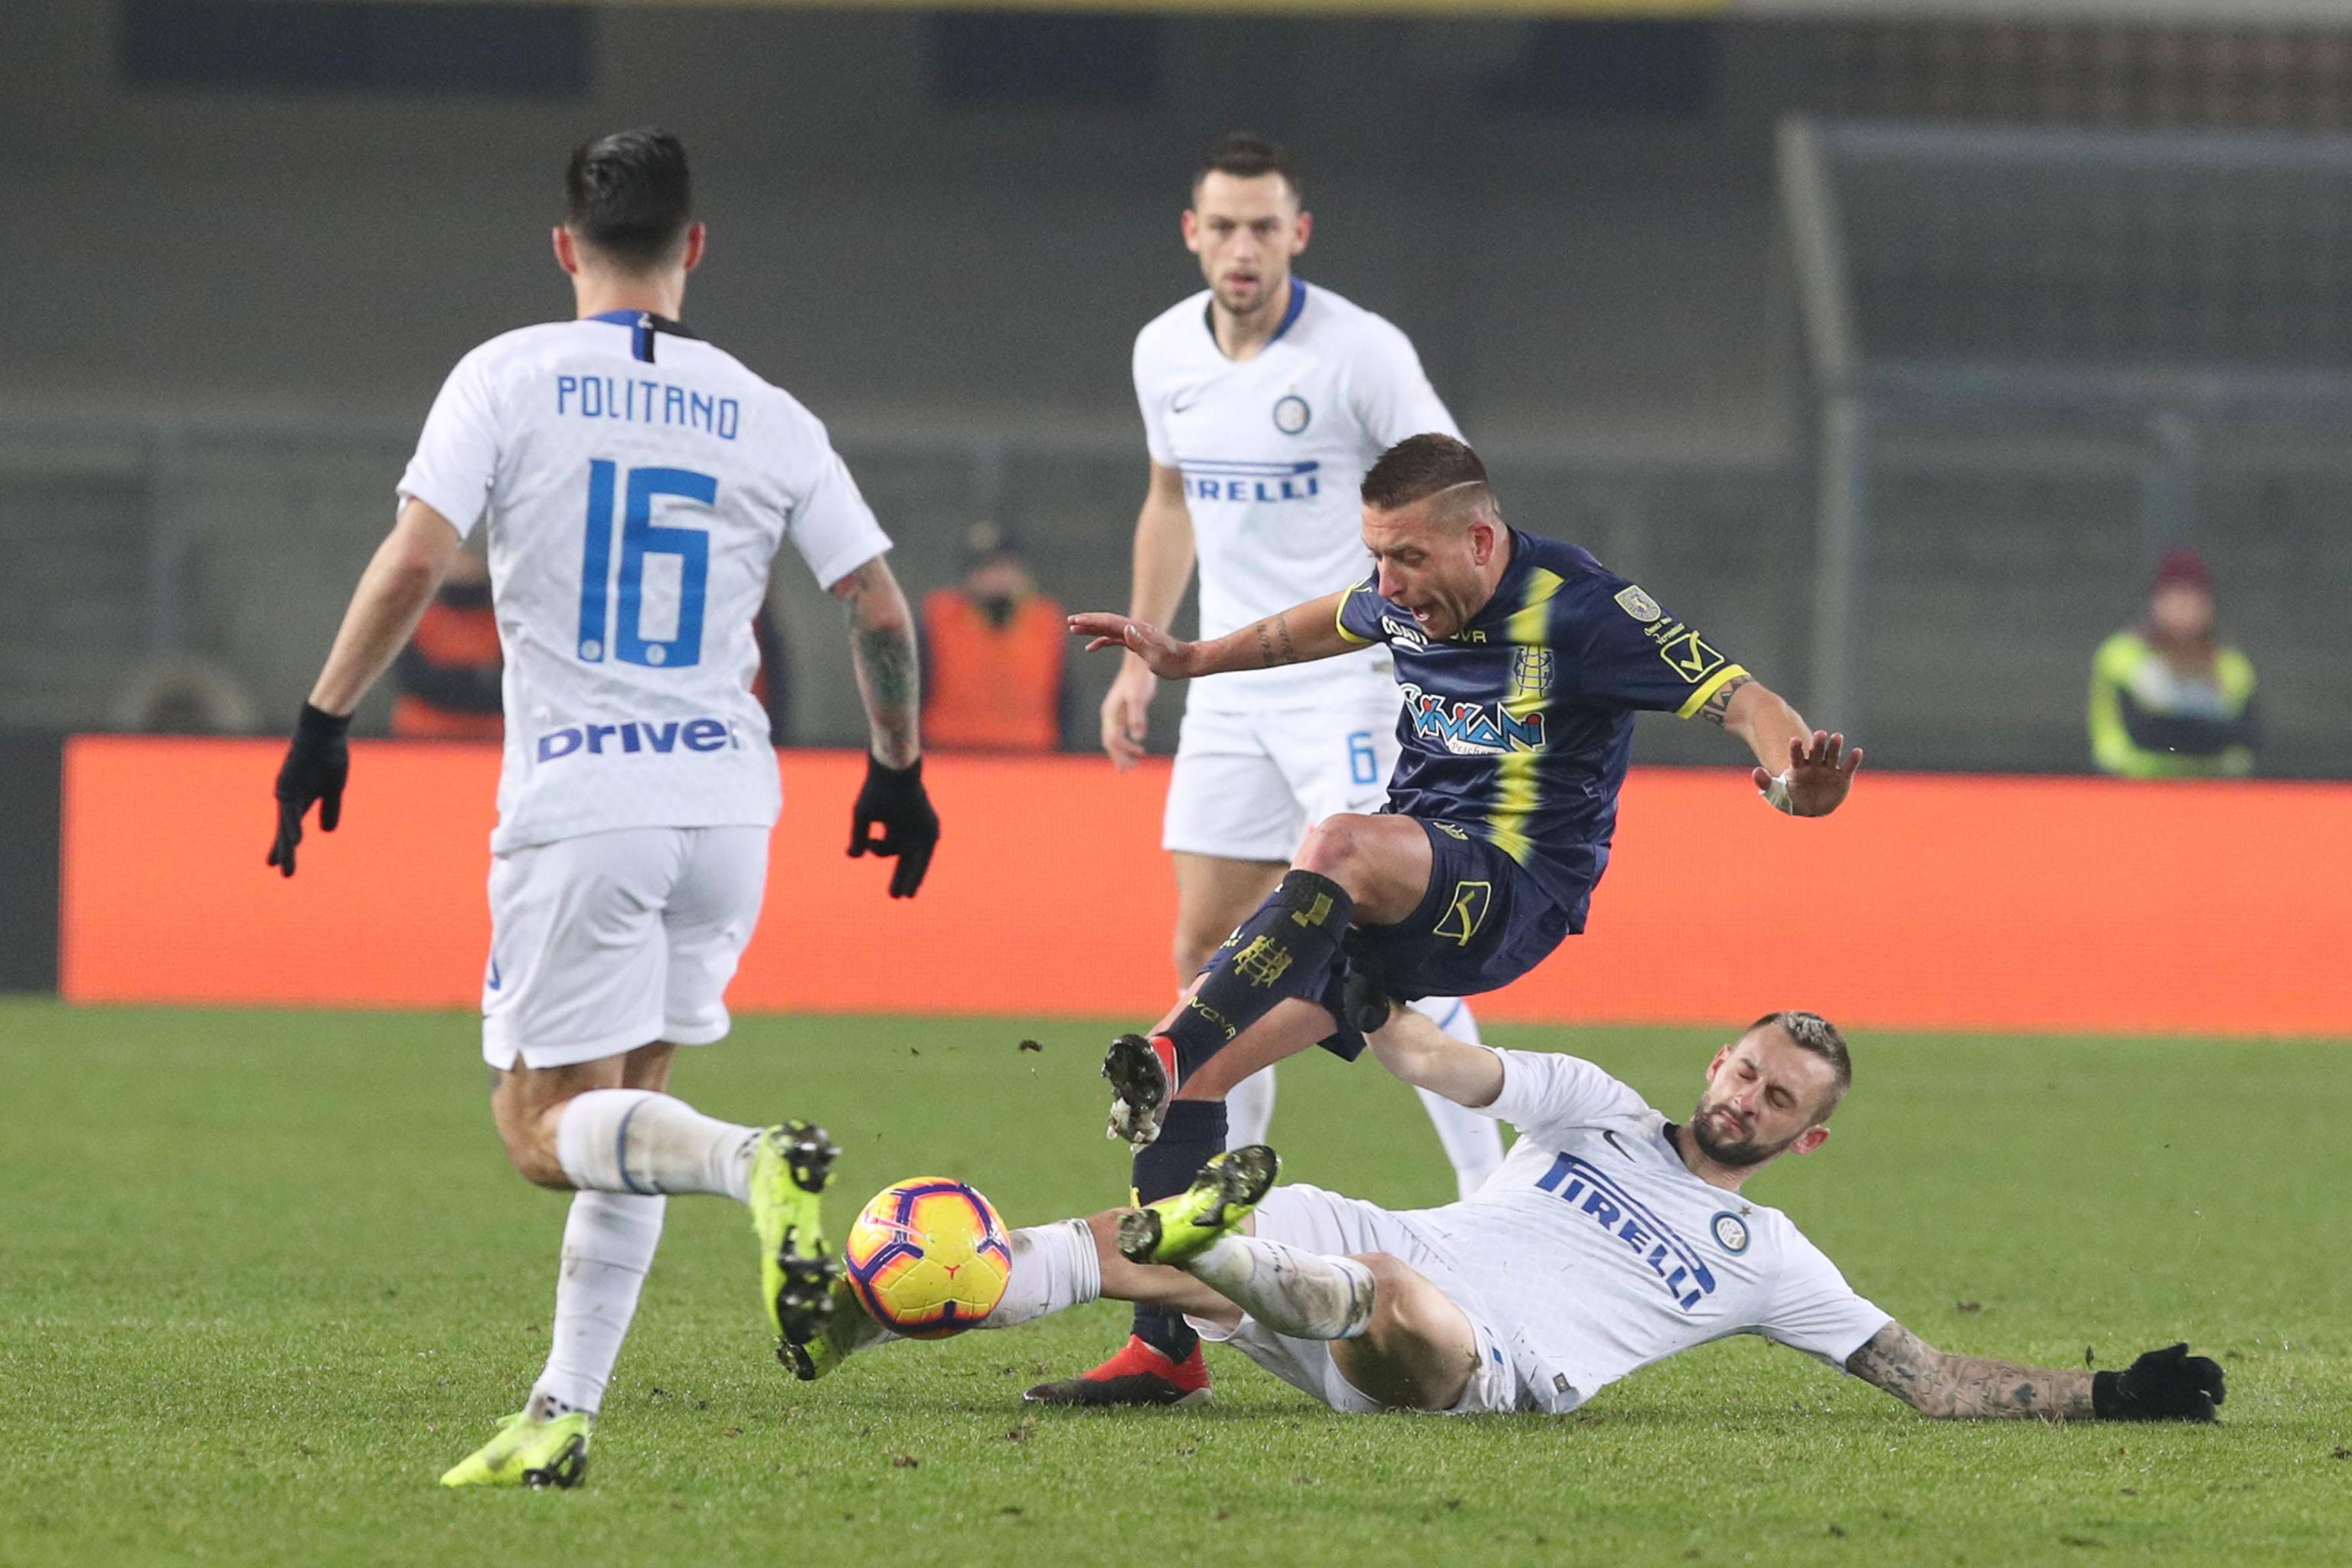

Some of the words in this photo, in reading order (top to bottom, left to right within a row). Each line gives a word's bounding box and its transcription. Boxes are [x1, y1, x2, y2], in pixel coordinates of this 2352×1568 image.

[557, 375, 739, 440] POLITANO
[1180, 459, 1319, 503] IRELLI
[577, 459, 717, 668] 16
[1347, 730, 1378, 784] 6
[1534, 1151, 1717, 1312] PIRELLI
